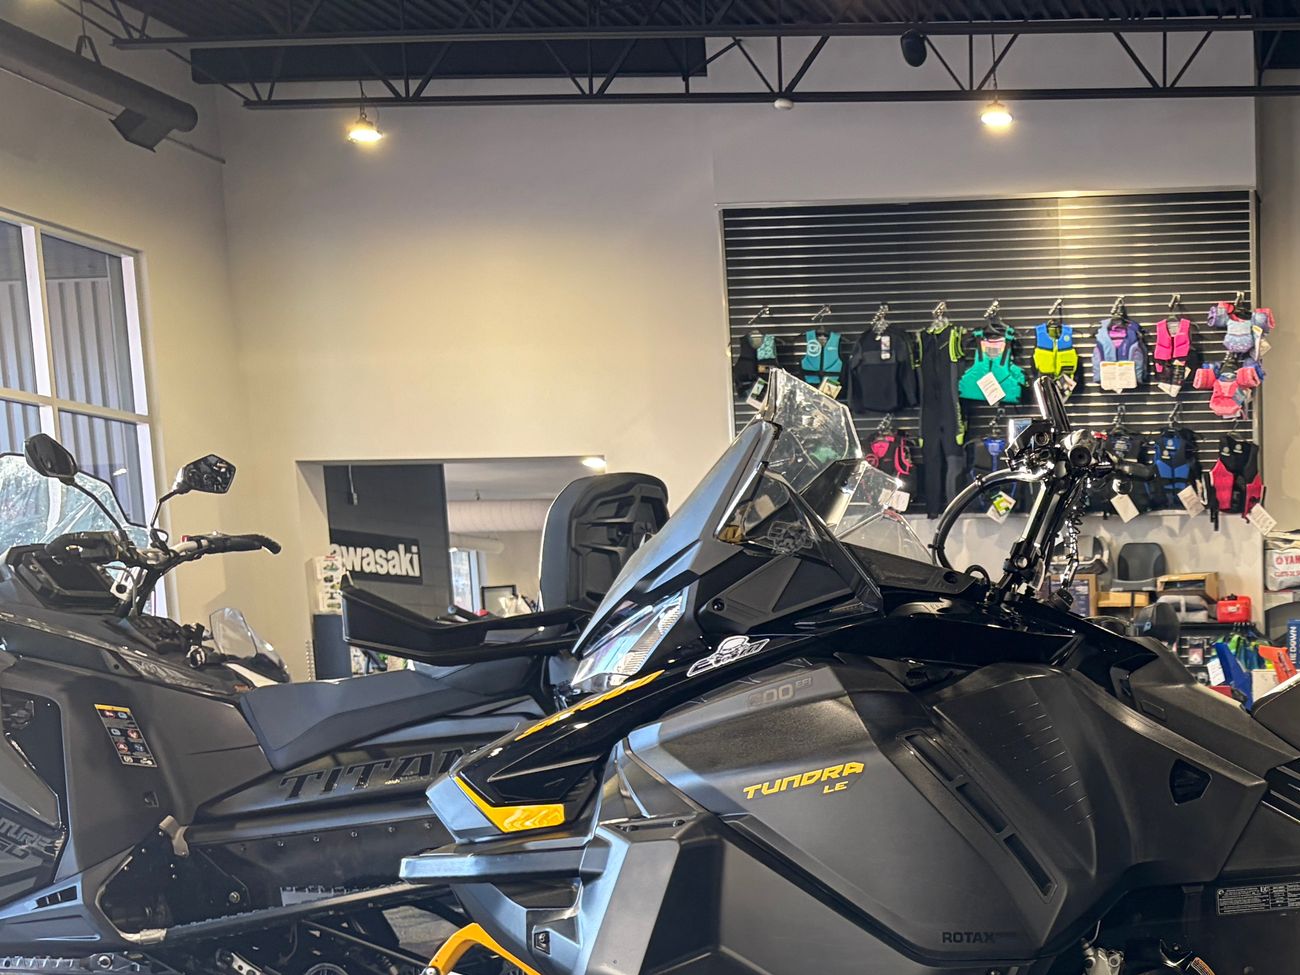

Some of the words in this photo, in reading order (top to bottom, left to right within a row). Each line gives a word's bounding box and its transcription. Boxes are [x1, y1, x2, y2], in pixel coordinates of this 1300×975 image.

[330, 543, 420, 577] awasaki
[743, 762, 864, 799] TUNDRA
[823, 781, 848, 793] LE
[942, 931, 995, 943] ROTAX
